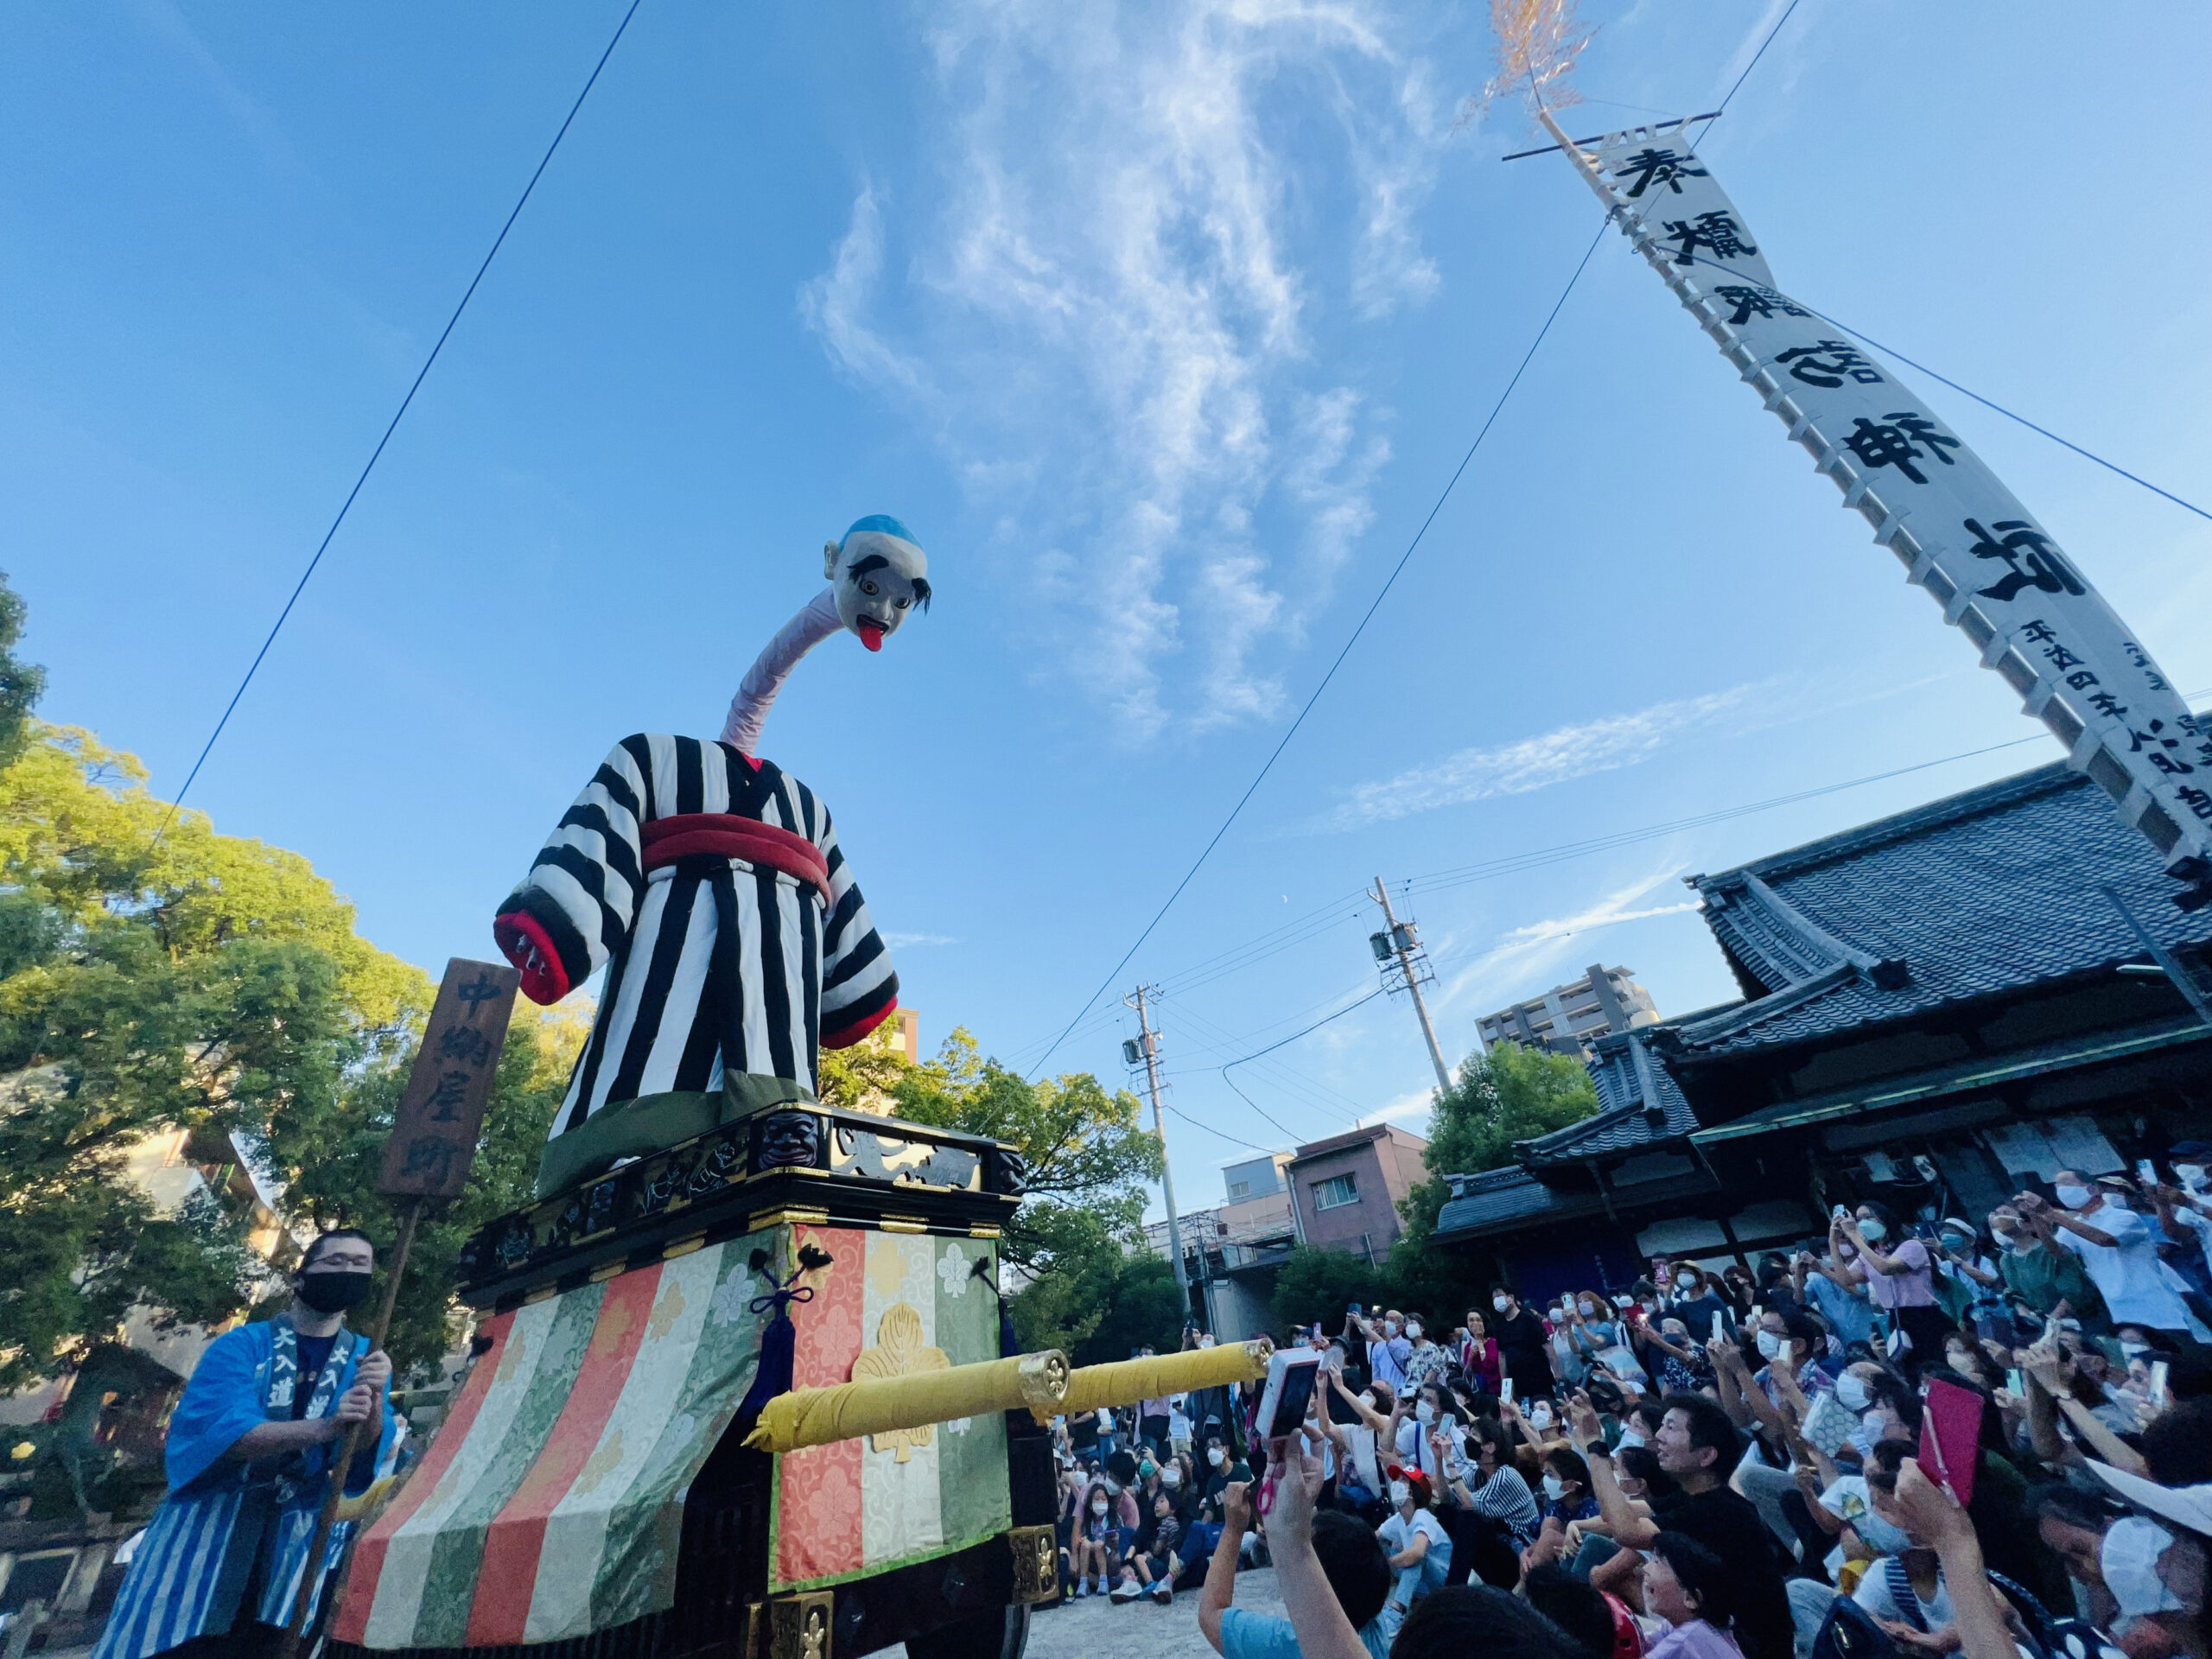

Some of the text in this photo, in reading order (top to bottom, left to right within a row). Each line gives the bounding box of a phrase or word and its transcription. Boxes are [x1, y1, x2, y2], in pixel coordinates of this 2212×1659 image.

[401, 969, 502, 1190] 中納屋町
[268, 1327, 296, 1408] 大入道
